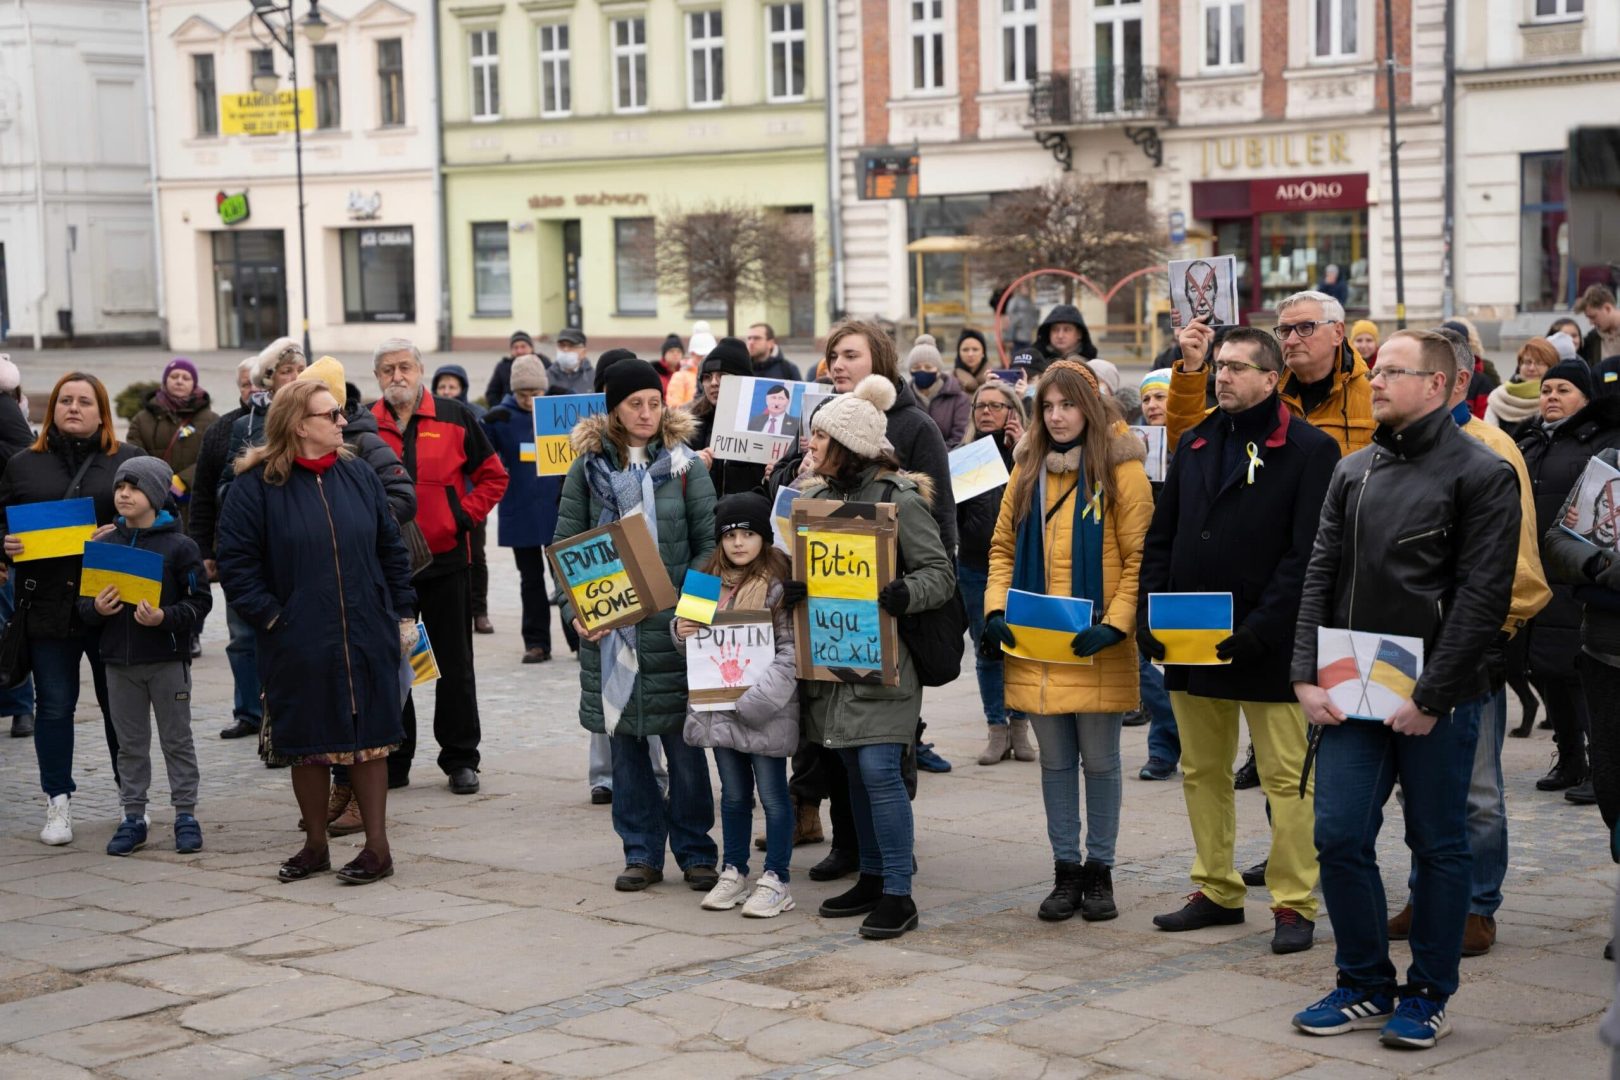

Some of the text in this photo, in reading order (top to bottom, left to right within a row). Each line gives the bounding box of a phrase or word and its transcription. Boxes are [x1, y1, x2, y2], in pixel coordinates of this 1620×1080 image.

[1202, 132, 1352, 177] JUBILER
[1275, 181, 1343, 200] ADORO
[714, 435, 748, 453] PUTIN
[561, 541, 620, 576] PUTIN
[810, 541, 870, 578] Putin
[586, 580, 614, 599] GO
[580, 588, 640, 622] HOME
[695, 625, 772, 649] PUTIN
